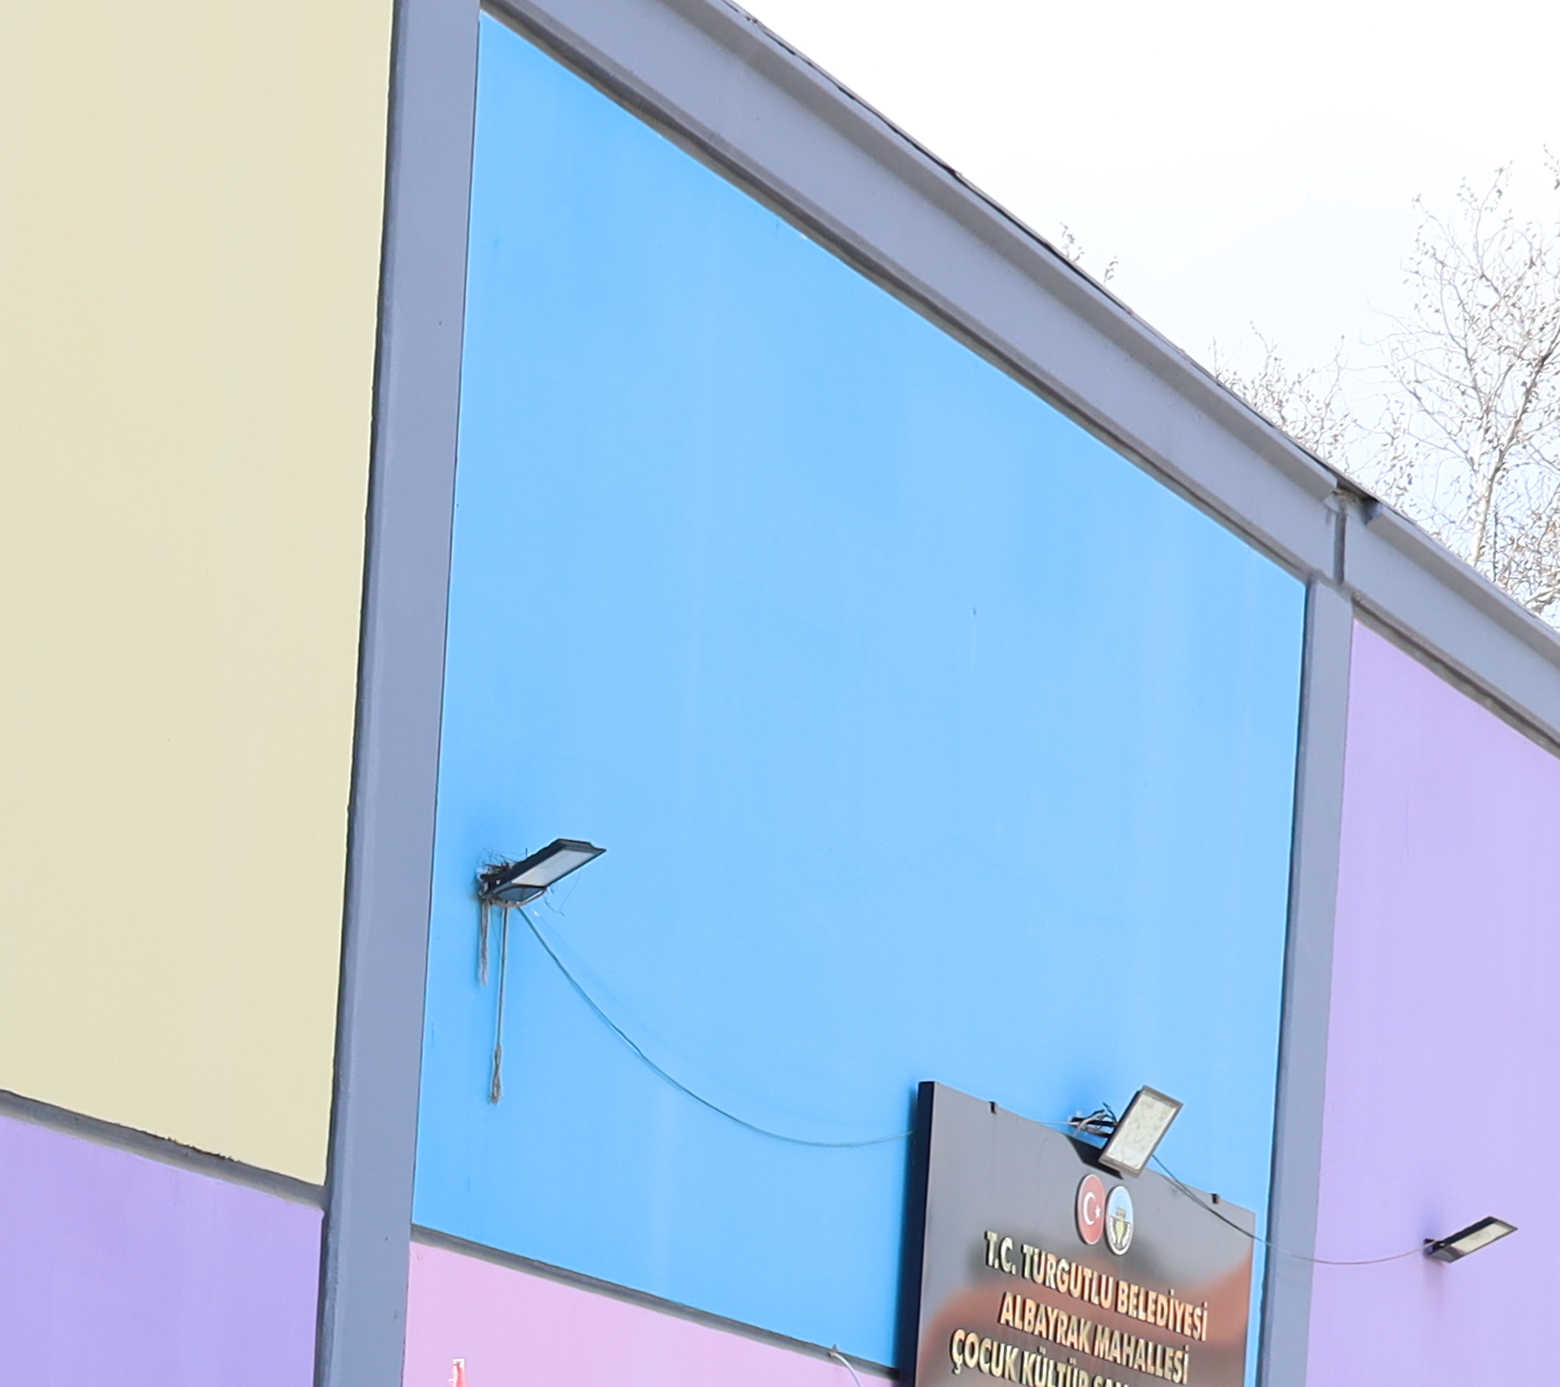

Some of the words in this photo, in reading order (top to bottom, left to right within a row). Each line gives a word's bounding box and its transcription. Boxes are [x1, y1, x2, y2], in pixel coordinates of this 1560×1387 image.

[984, 1230, 1017, 1276] T.C.
[1021, 1243, 1114, 1308] TURGUTLU
[1115, 1279, 1208, 1342] BELEDİYESİ
[950, 1329, 1020, 1382] ÇOCUK
[998, 1291, 1093, 1354] ALBAYRAK
[1093, 1324, 1190, 1385] MAHALLESİ
